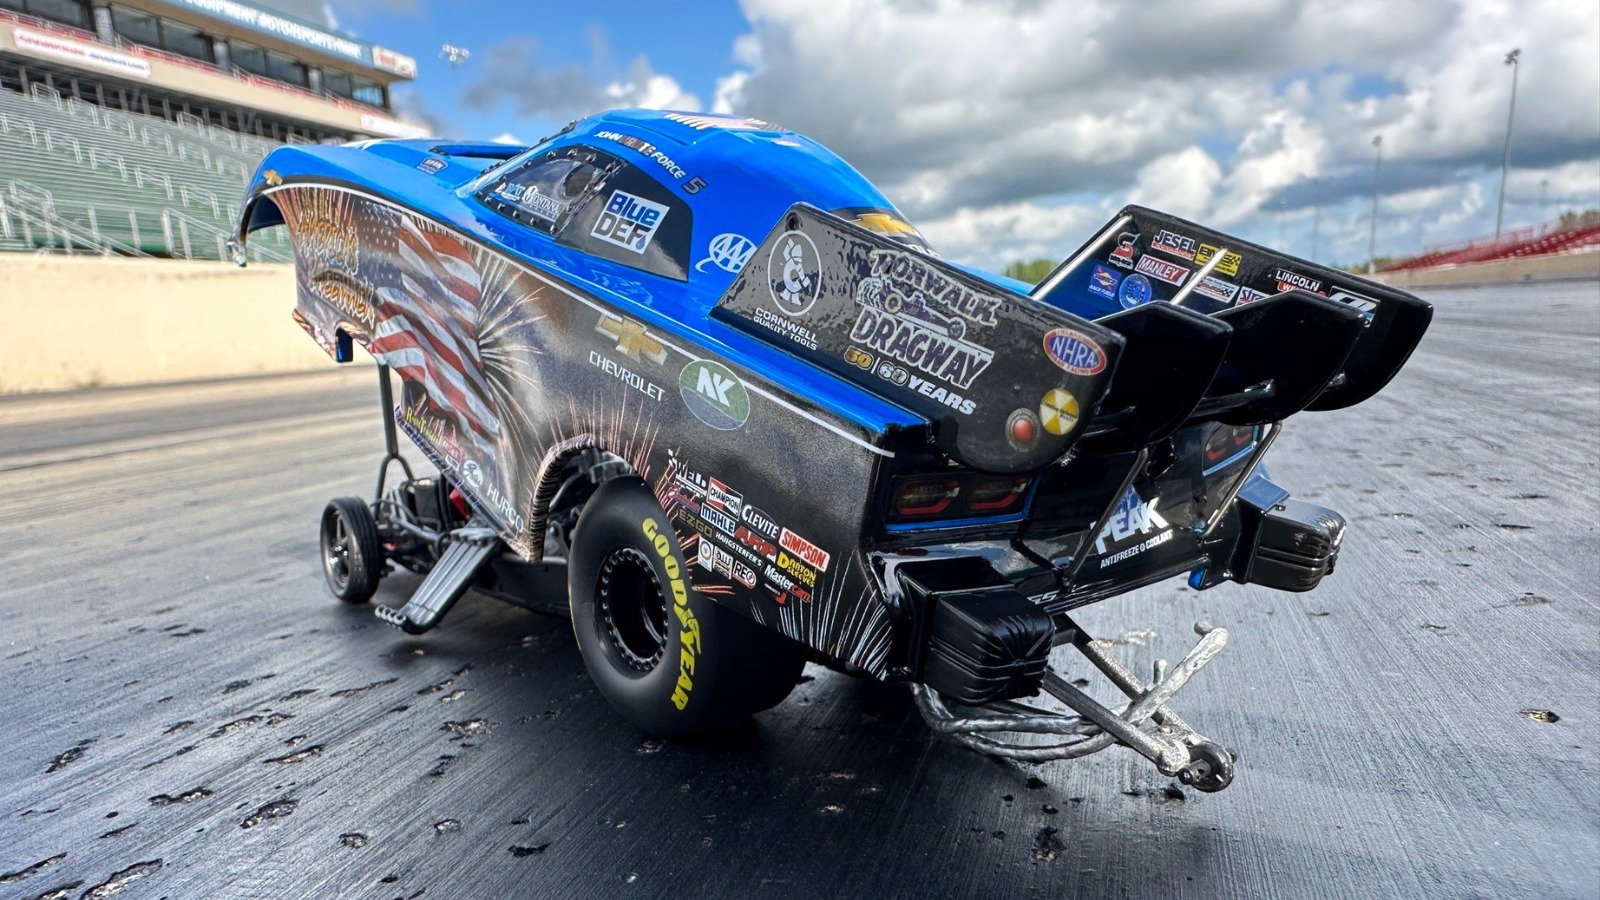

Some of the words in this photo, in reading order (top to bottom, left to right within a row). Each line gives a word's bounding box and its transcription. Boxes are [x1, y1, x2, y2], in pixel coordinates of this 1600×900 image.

[594, 131, 622, 140] JOHN
[651, 151, 686, 179] FORCE
[683, 176, 707, 194] 5
[606, 192, 660, 226] Blue
[595, 212, 651, 246] DEF
[1152, 229, 1195, 255] JESEL
[710, 234, 757, 270] AAA
[1139, 257, 1180, 281] MANLEY
[870, 249, 1001, 327] NORWALK
[1275, 270, 1320, 291] LINCOLN
[753, 315, 787, 336] QUALITY
[790, 333, 817, 350] TOOLS
[755, 307, 818, 343] CORNWELL
[850, 306, 995, 390] DRAGWAY
[1052, 336, 1099, 367] NHRA
[589, 351, 665, 401] CHEVROLET
[697, 366, 735, 407] NK
[908, 375, 976, 415] YEARS
[487, 483, 524, 532] HURCO
[710, 486, 740, 514] CHAMPION
[701, 505, 735, 535] MAHLE
[742, 504, 780, 539] CLEVITE
[1090, 497, 1171, 555] PEAK
[781, 530, 826, 570] SIMPSON
[1100, 544, 1140, 569] ANTIFREEZE
[1145, 529, 1174, 550] COOLANT
